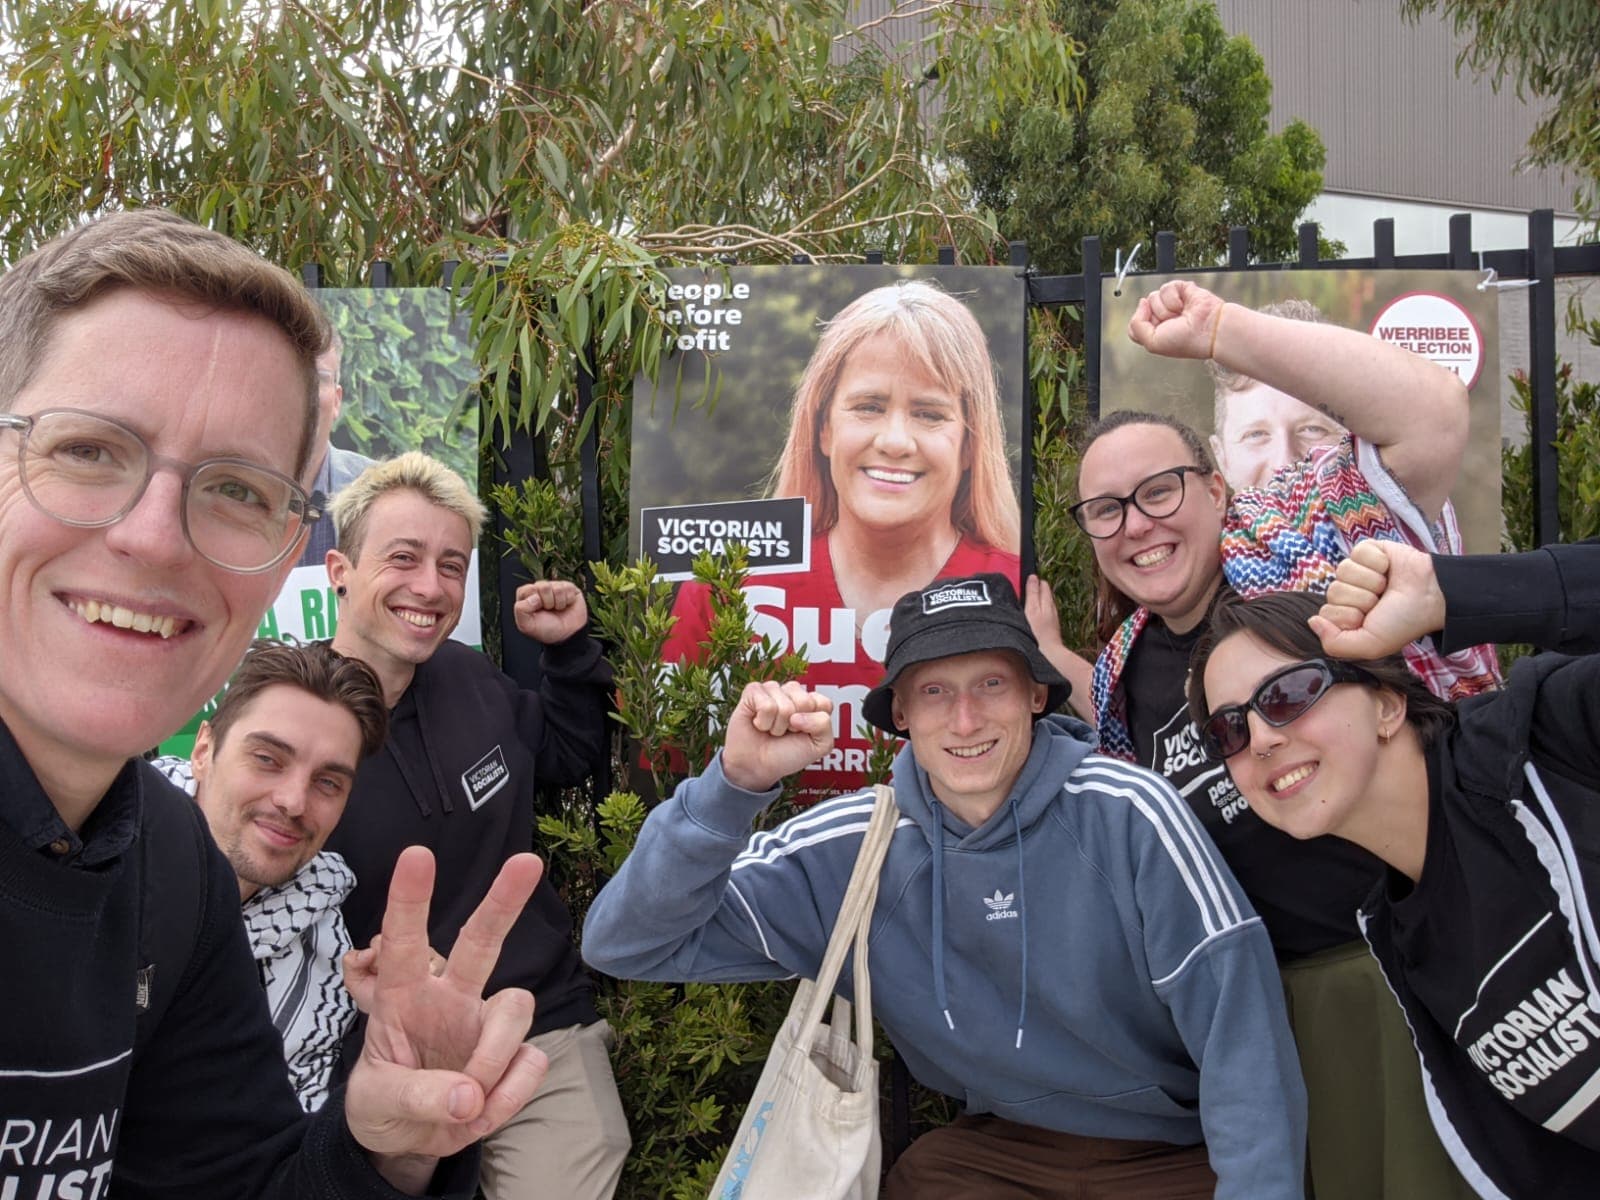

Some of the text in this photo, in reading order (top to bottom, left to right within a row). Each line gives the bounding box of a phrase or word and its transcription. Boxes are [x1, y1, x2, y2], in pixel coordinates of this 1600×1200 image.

[656, 303, 742, 325] efore
[1379, 327, 1469, 340] WERRIBEE
[657, 518, 782, 539] VICTORIAN
[657, 536, 791, 557] SOCIASTS
[929, 588, 979, 601] VICTORIAN
[468, 760, 498, 784] VICTORIAN
[472, 765, 505, 793] SOCIALISTS
[985, 909, 1018, 921] adidas
